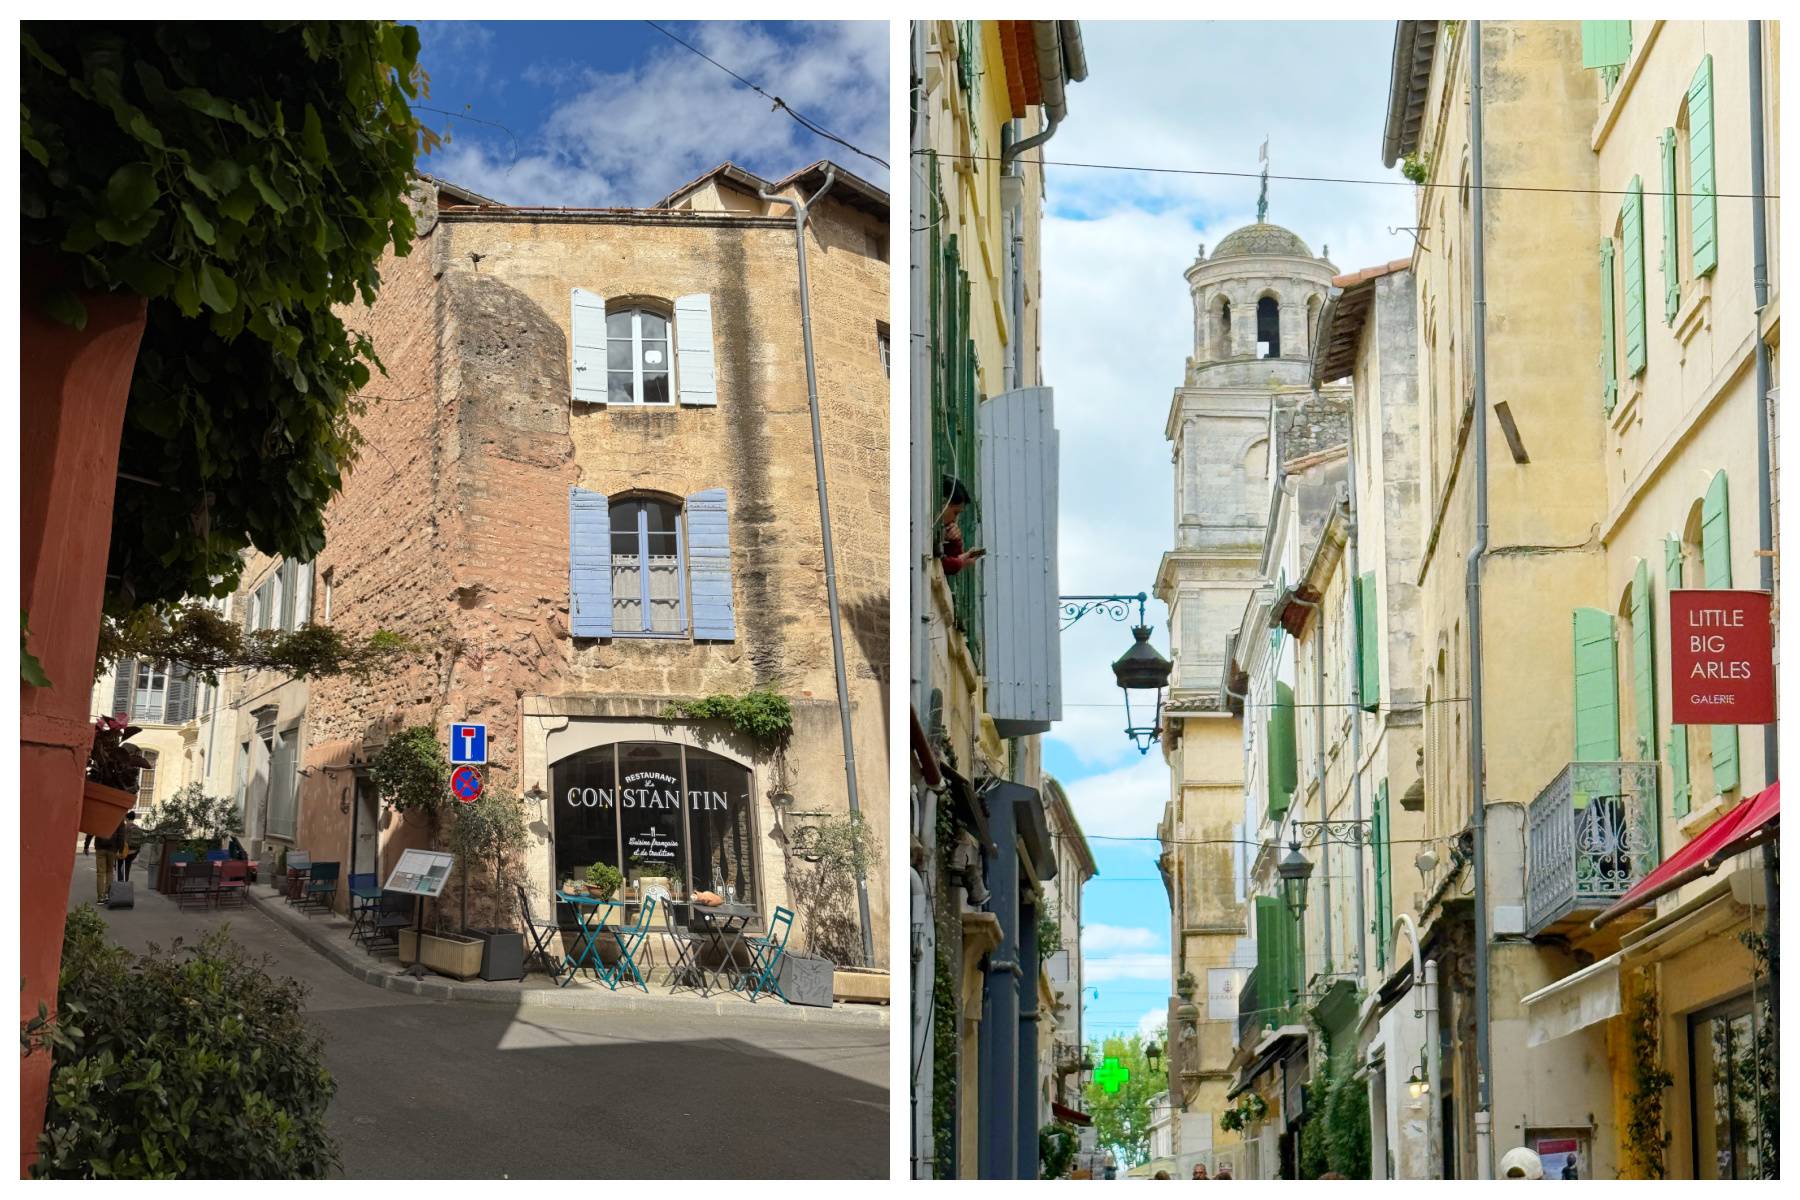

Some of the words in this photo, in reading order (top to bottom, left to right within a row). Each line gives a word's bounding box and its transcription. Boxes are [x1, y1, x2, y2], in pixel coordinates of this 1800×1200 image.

[1690, 610, 1744, 627] LITTLE
[1690, 635, 1725, 653] BIG
[1690, 661, 1751, 679] ARLES
[1690, 694, 1735, 705] GALERIE
[625, 771, 677, 784] RESTAURANT
[644, 779, 655, 788] Le
[628, 836, 651, 846] Cuisine
[651, 837, 679, 851] française
[633, 847, 640, 856] et
[640, 847, 648, 856] de
[648, 848, 675, 857] tradition
